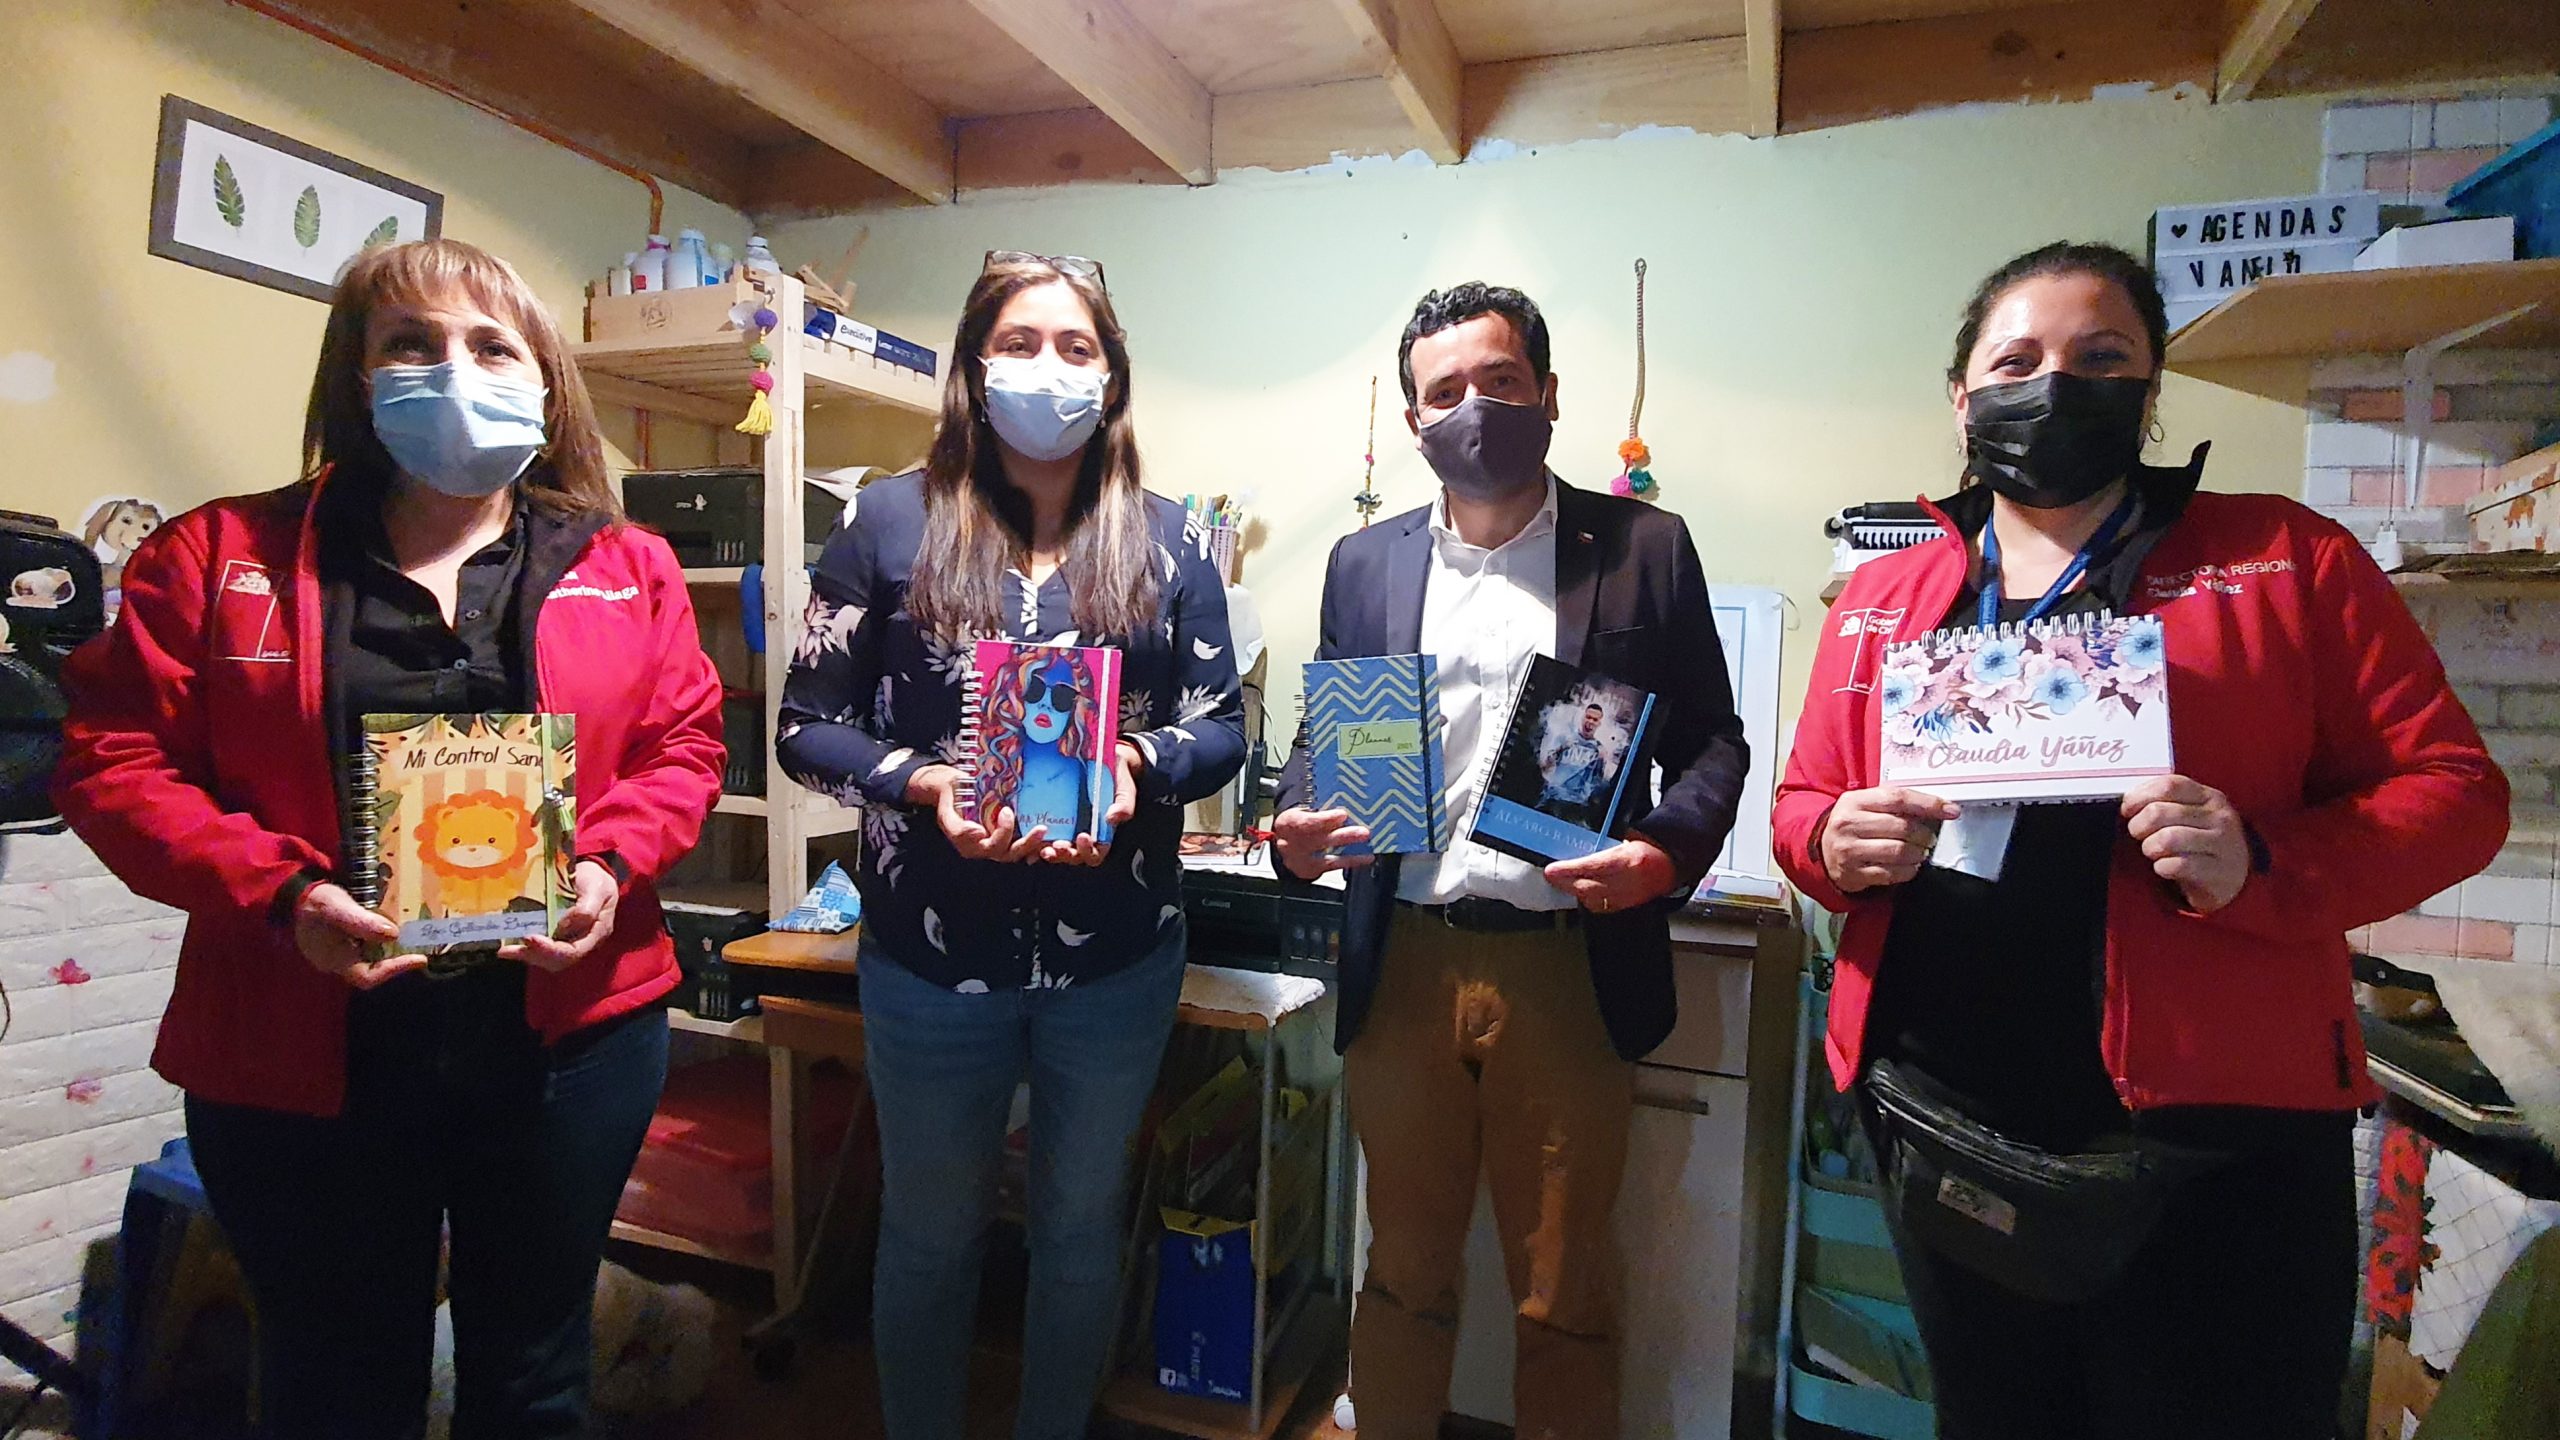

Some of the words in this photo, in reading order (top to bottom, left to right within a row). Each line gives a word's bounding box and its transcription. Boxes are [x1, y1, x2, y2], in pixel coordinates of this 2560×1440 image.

[2200, 205, 2347, 243] AGENDAS
[403, 748, 426, 769] Mi
[434, 745, 500, 766] Control
[1928, 738, 2030, 769] Claudia
[2041, 735, 2130, 768] Yáñez
[1553, 828, 1596, 852] RAMO
